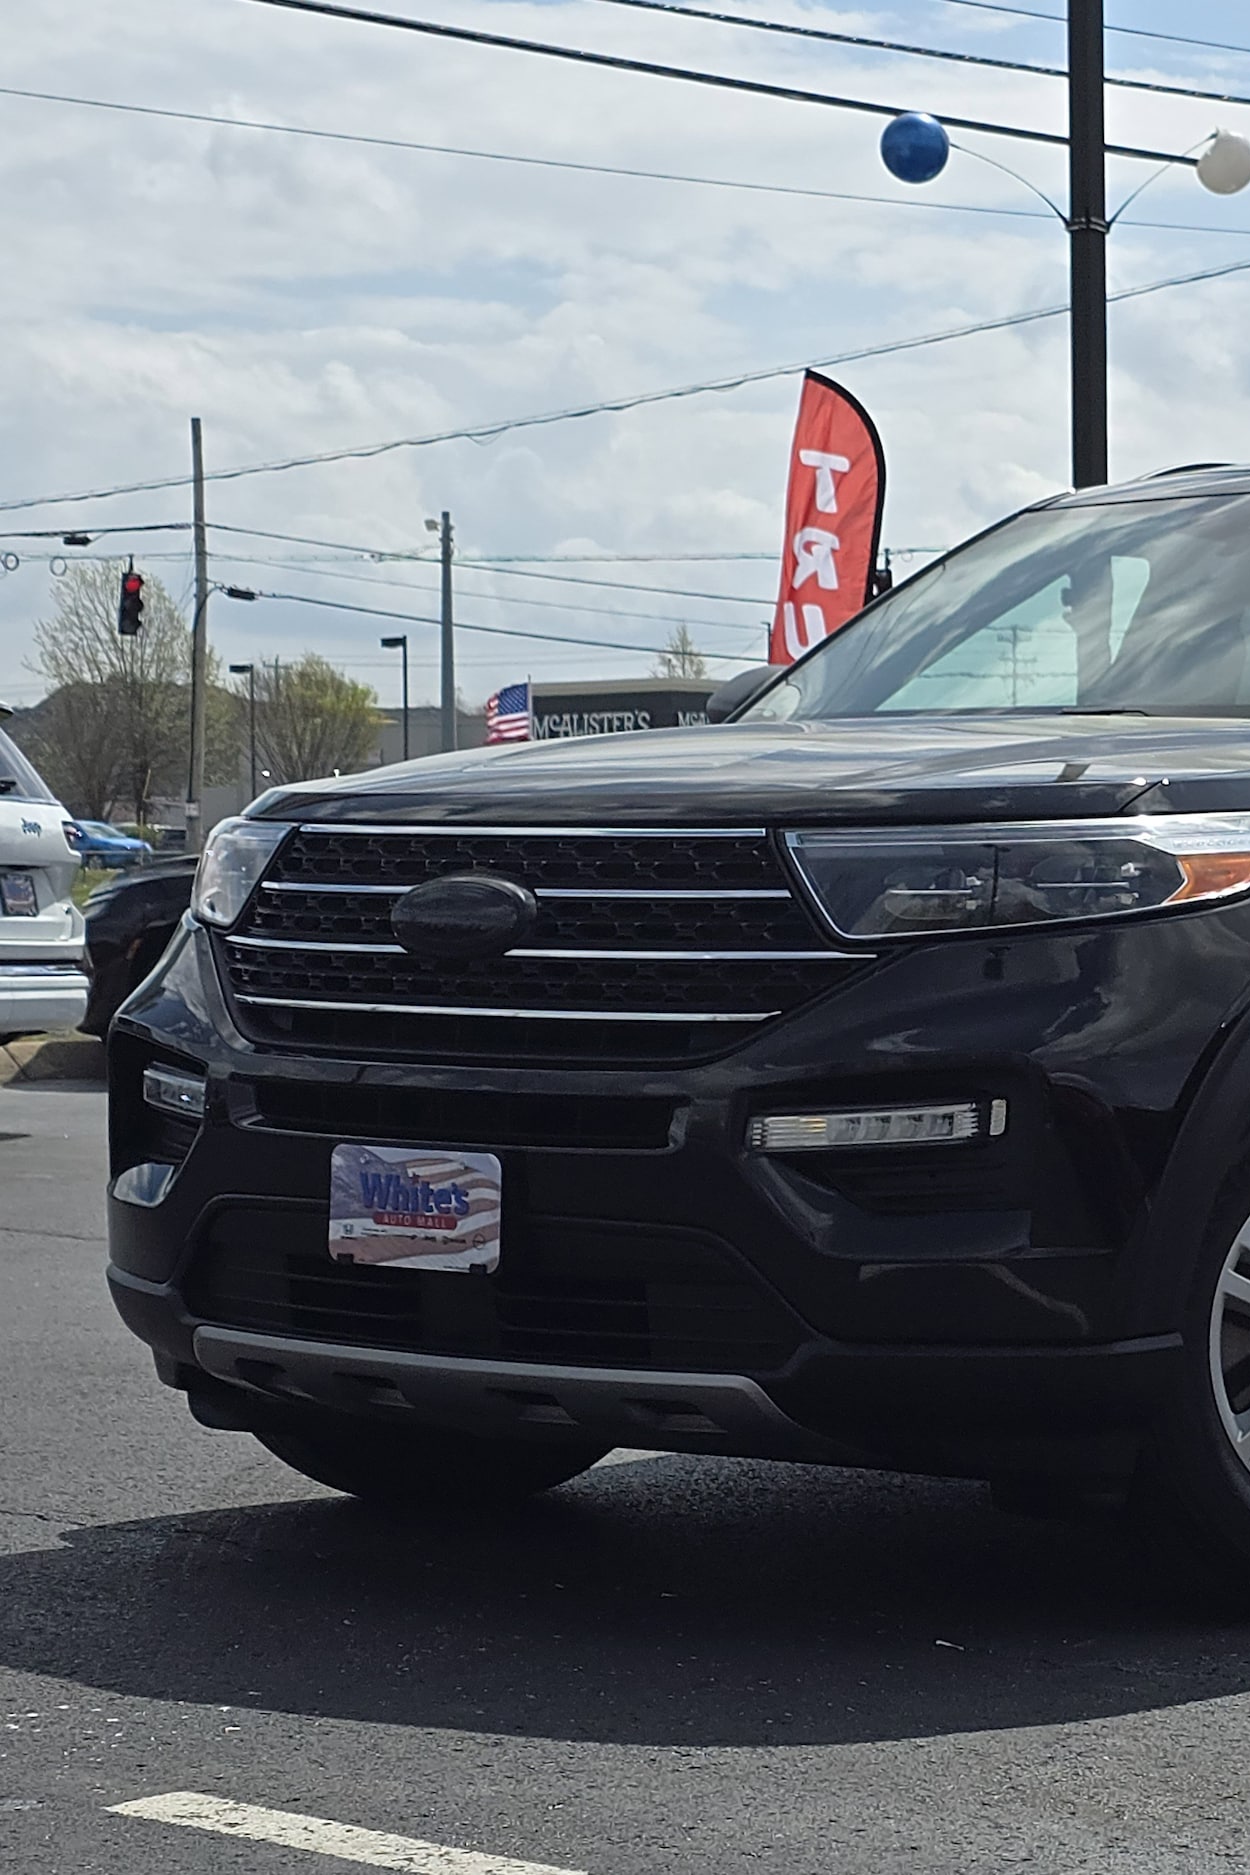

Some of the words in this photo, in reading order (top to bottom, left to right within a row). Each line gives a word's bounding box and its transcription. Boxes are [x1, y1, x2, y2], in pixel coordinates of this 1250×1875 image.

[359, 1171, 471, 1216] White's
[382, 1215, 411, 1227] AUTO
[416, 1217, 447, 1229] MALL
